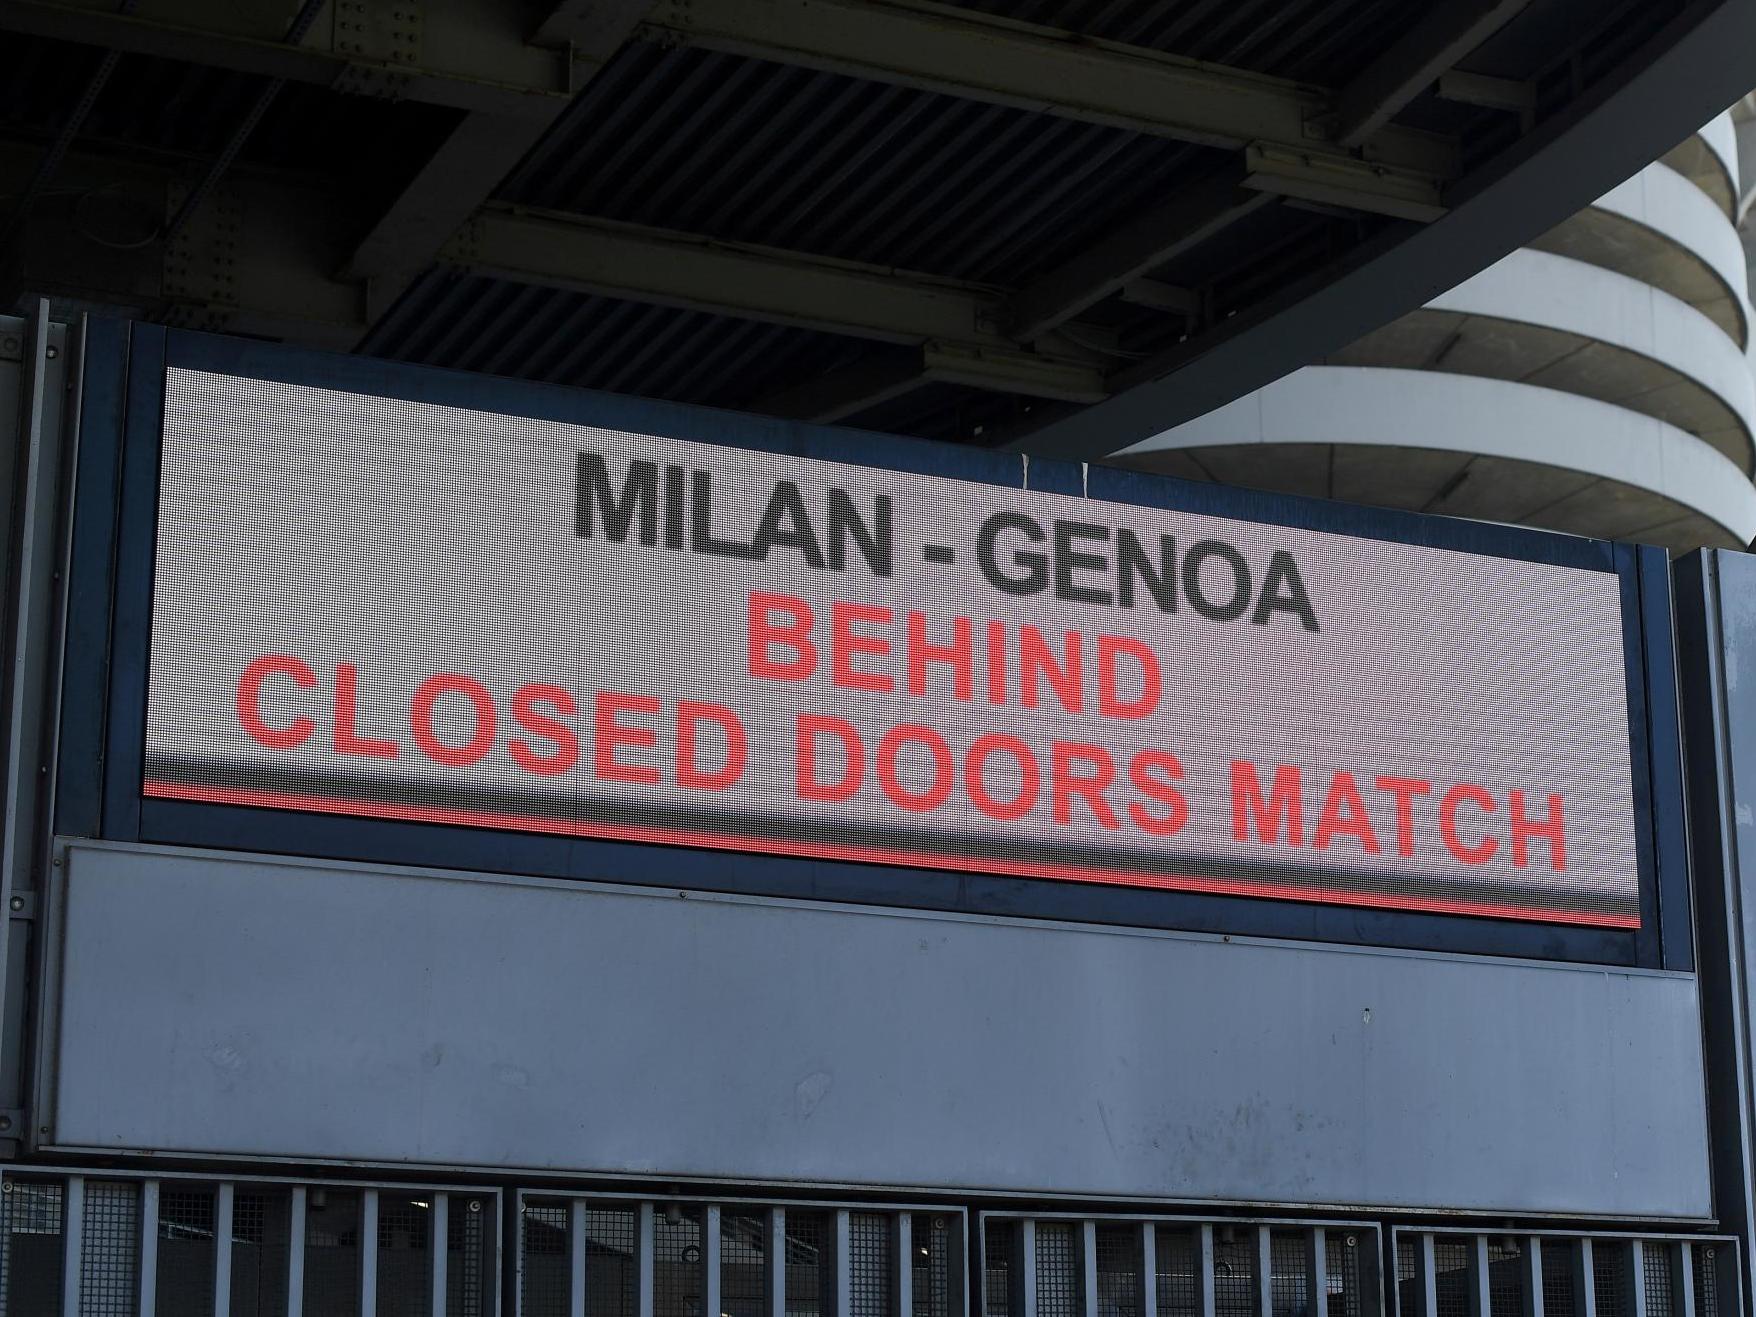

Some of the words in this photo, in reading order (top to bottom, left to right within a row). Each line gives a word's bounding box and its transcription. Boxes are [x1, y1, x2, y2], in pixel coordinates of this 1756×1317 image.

[576, 453, 893, 577] MILAN
[924, 545, 953, 562] -
[977, 510, 1320, 631] GENOA
[748, 592, 1161, 717] BEHIND
[238, 654, 745, 790] CLOSED
[798, 715, 1185, 833] DOORS
[1231, 762, 1565, 871] MATCH
